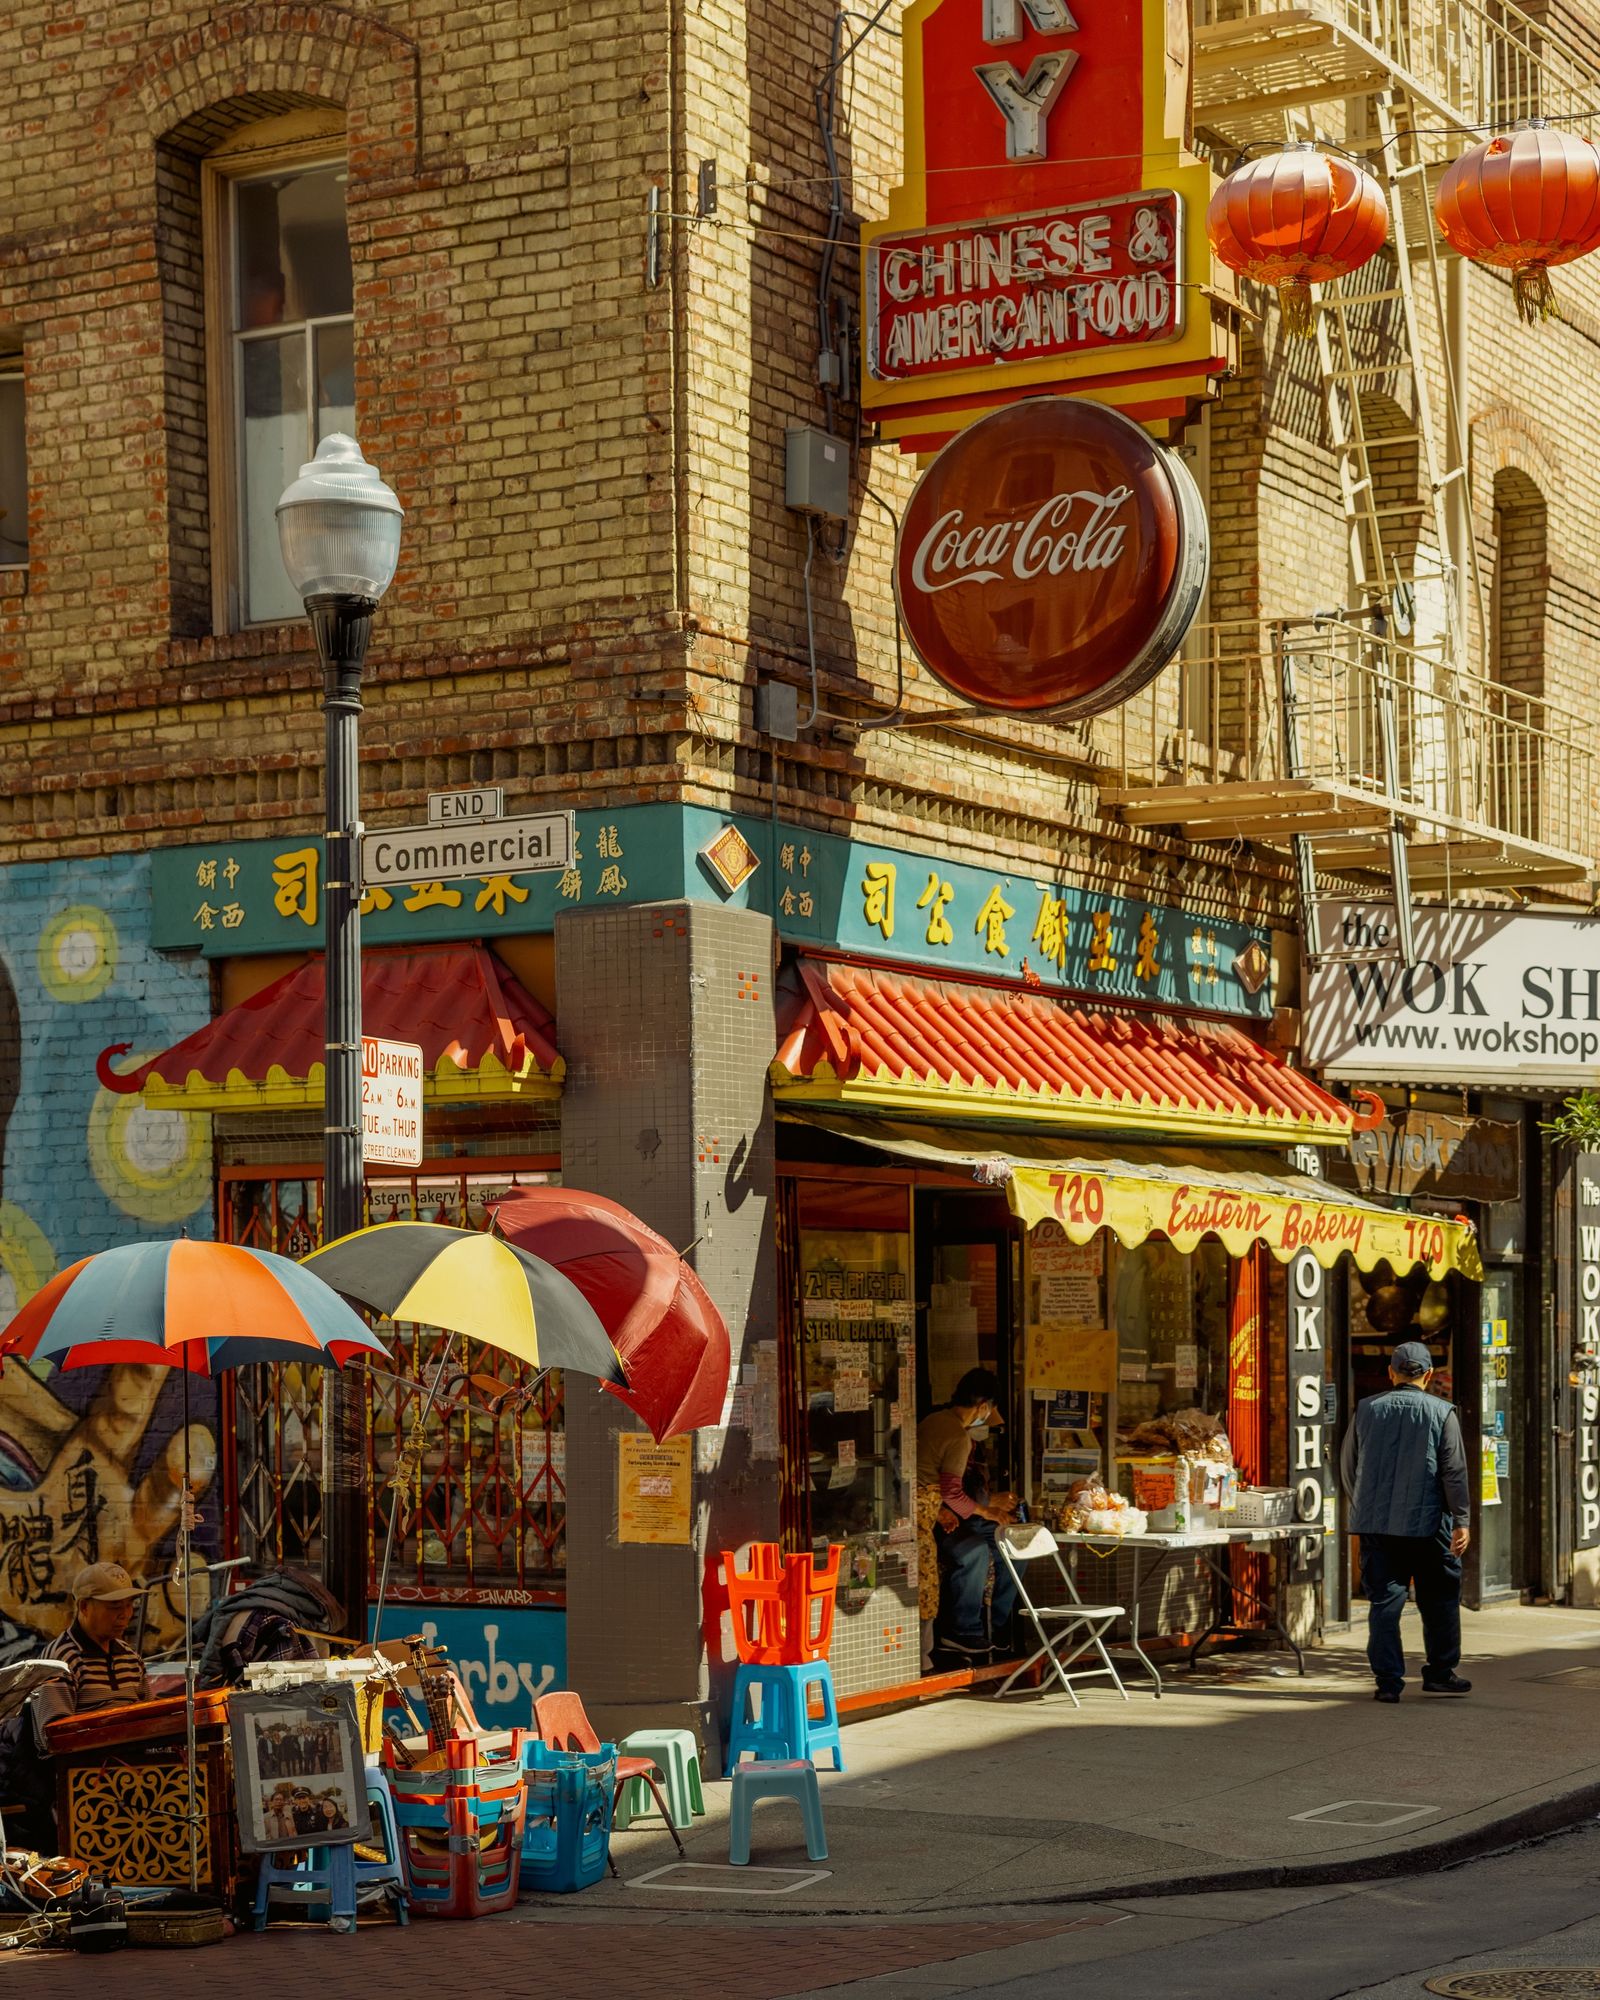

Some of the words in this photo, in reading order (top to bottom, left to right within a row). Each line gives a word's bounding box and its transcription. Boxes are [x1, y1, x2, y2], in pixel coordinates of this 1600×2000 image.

[884, 214, 1112, 303] CHINESE
[1128, 207, 1170, 264] &
[885, 289, 1063, 370] AMERICAN
[1064, 270, 1170, 342] FOOD
[441, 793, 484, 818] END
[375, 825, 552, 873] Commercial
[1342, 913, 1390, 948] the
[1342, 957, 1490, 1017] WOK
[380, 1053, 419, 1079] PARKING
[362, 1114, 379, 1134] TUE
[393, 1118, 417, 1138] THUR
[364, 1144, 385, 1158] STREET
[386, 1146, 417, 1161] CLEANING
[1295, 1144, 1320, 1177] the
[368, 1190, 410, 1206] astern
[415, 1189, 456, 1206] akery
[1048, 1173, 1105, 1225] 720
[1168, 1184, 1272, 1237] Eastern
[1281, 1203, 1366, 1252] Bakery
[1404, 1219, 1444, 1264] 720
[1295, 1253, 1322, 1350] OK
